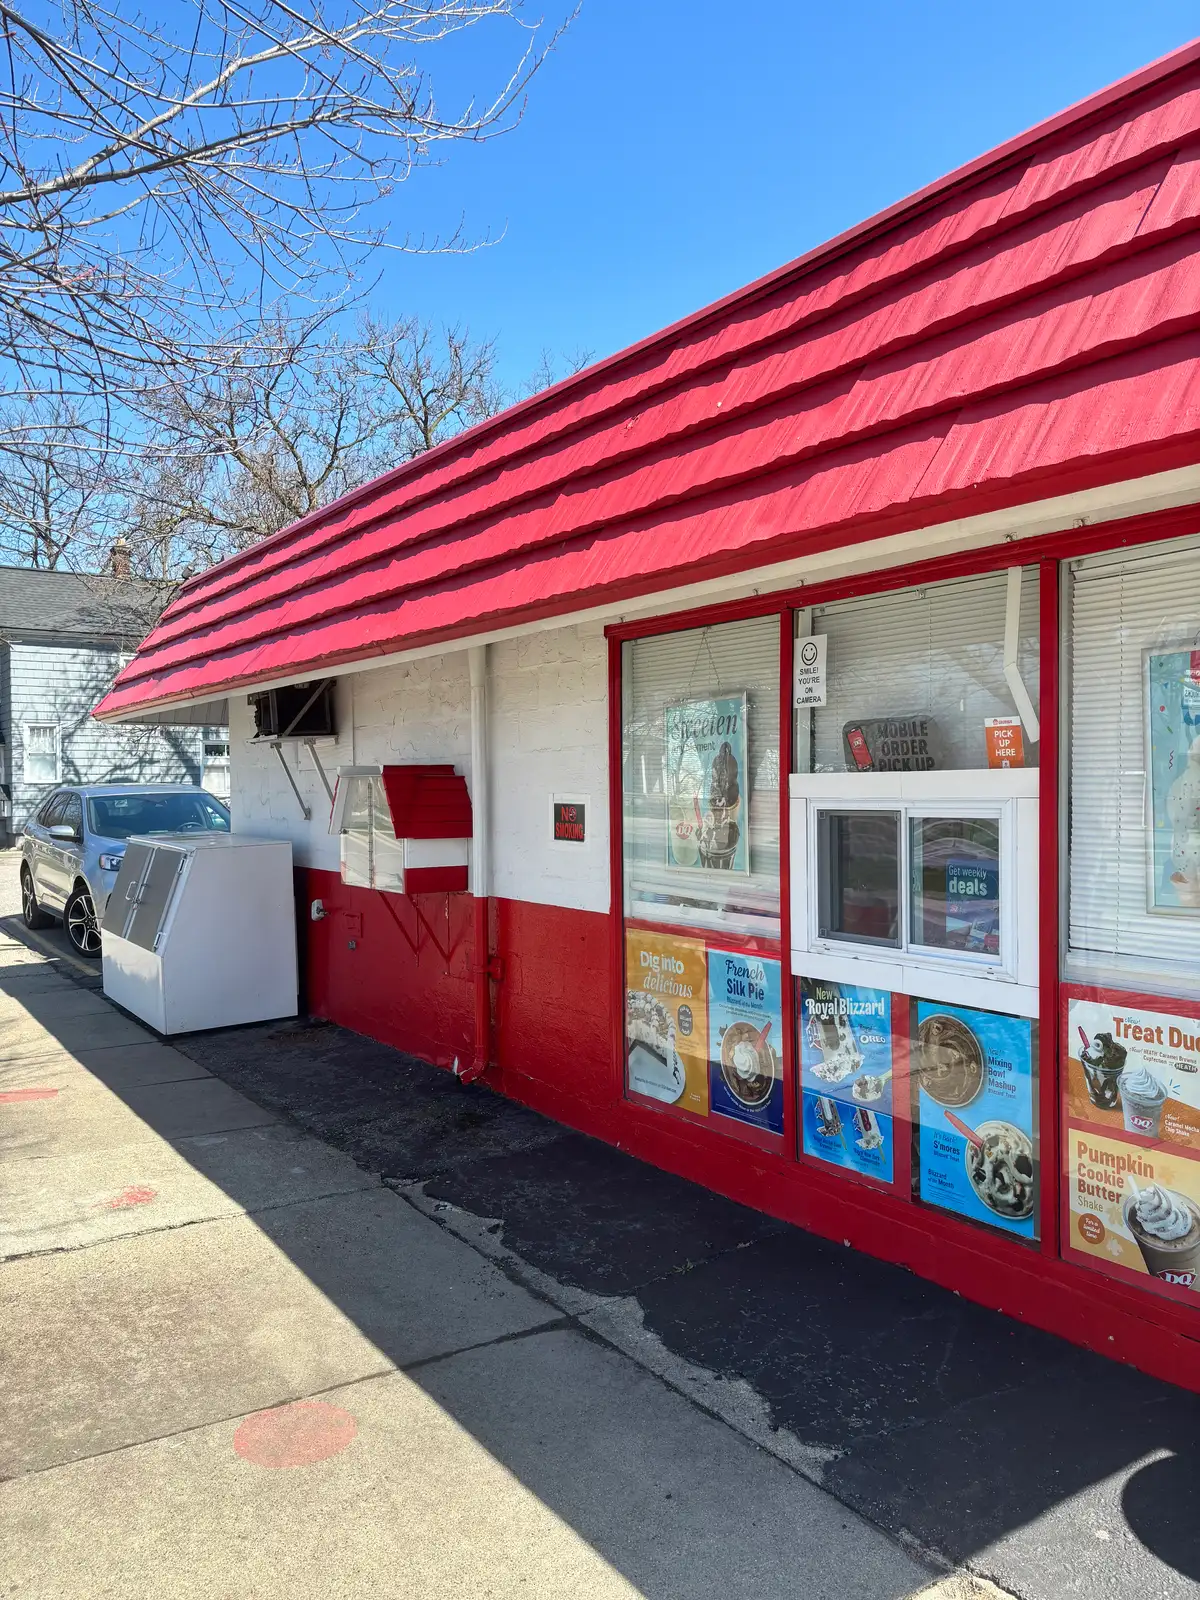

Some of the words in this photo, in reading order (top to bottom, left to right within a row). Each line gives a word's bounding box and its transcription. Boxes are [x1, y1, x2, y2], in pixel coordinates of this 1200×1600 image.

[799, 666, 819, 675] SMILE!
[798, 676, 820, 685] YOU'RE
[804, 686, 813, 694] ON
[796, 695, 822, 704] CAMERA
[877, 721, 929, 739] MOBILE
[994, 729, 1014, 738] PICK
[881, 739, 929, 757] ORDER
[999, 739, 1010, 748] UP
[995, 748, 1016, 757] HERE
[878, 757, 911, 772] PICK
[915, 756, 935, 771] UP
[561, 806, 577, 822] NO
[555, 821, 585, 840] SMOKING
[948, 864, 960, 876] Get
[962, 866, 987, 880] weekly
[948, 877, 988, 897] deals
[640, 950, 660, 973] Dig
[661, 954, 685, 974] into
[725, 959, 765, 981] French
[643, 971, 692, 999] delicious
[726, 978, 746, 998] Silk
[748, 982, 765, 1001] Pie
[816, 987, 833, 1000] New
[805, 998, 838, 1020] Royal
[840, 997, 885, 1016] Blizzard
[1112, 1016, 1164, 1046] Treat
[860, 1034, 886, 1044] OREO
[988, 1056, 1013, 1071] Mixing
[1159, 1051, 1179, 1061] Caramel
[988, 1067, 1006, 1078] Bowl
[1175, 1063, 1198, 1073] HEATH
[988, 1078, 1017, 1093] Mashup
[1132, 1117, 1151, 1128] DQ
[1164, 1119, 1184, 1129] Caramel
[1184, 1124, 1200, 1133] Mocha
[1164, 1126, 1175, 1134] Chip
[933, 1140, 960, 1155] S'mores
[1077, 1140, 1154, 1179] Pumpkin
[1077, 1163, 1124, 1188] Cookie
[1077, 1178, 1122, 1204] Butter
[1077, 1195, 1104, 1213] Shake
[1164, 1271, 1193, 1286] DQ
